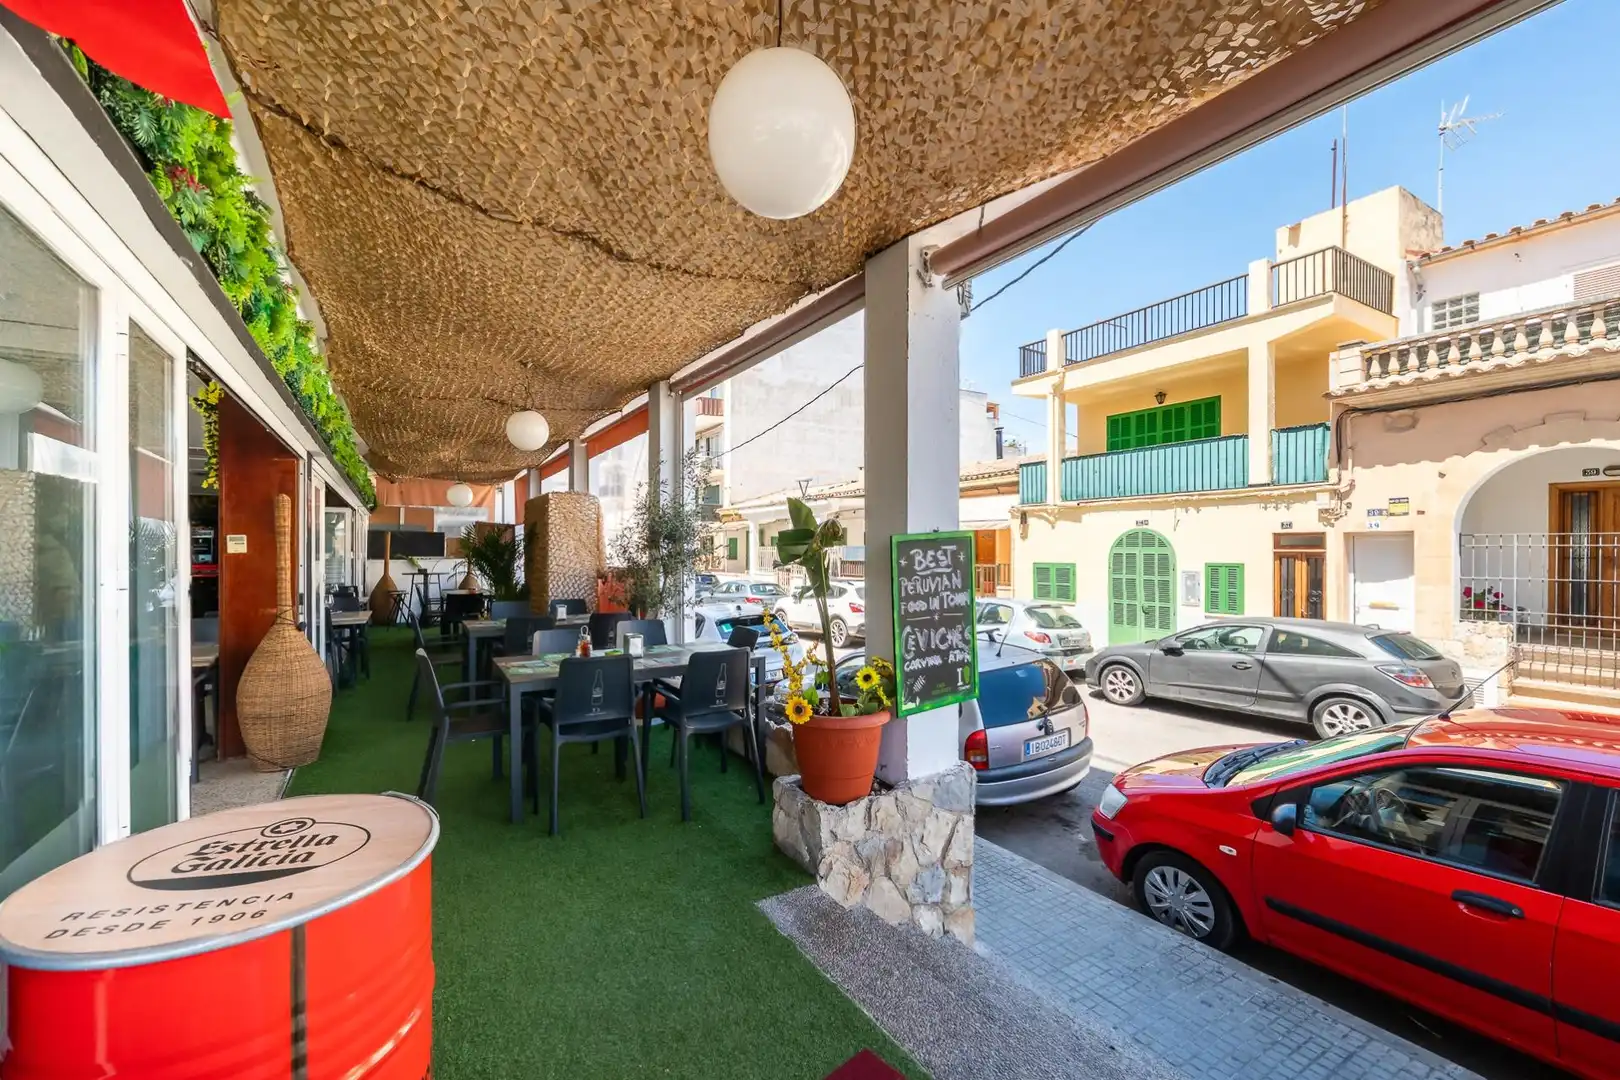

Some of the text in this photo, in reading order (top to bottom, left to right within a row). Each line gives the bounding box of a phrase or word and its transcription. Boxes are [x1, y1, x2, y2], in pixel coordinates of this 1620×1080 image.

[909, 545, 957, 571] BEST
[899, 569, 962, 597] PERUVIAN
[900, 589, 971, 615] FOOD IN TOWN
[185, 833, 340, 860] Estrella
[171, 848, 316, 875] Galicia
[61, 891, 296, 922] RESISTENCIA
[44, 909, 268, 940] DESDE 1906
